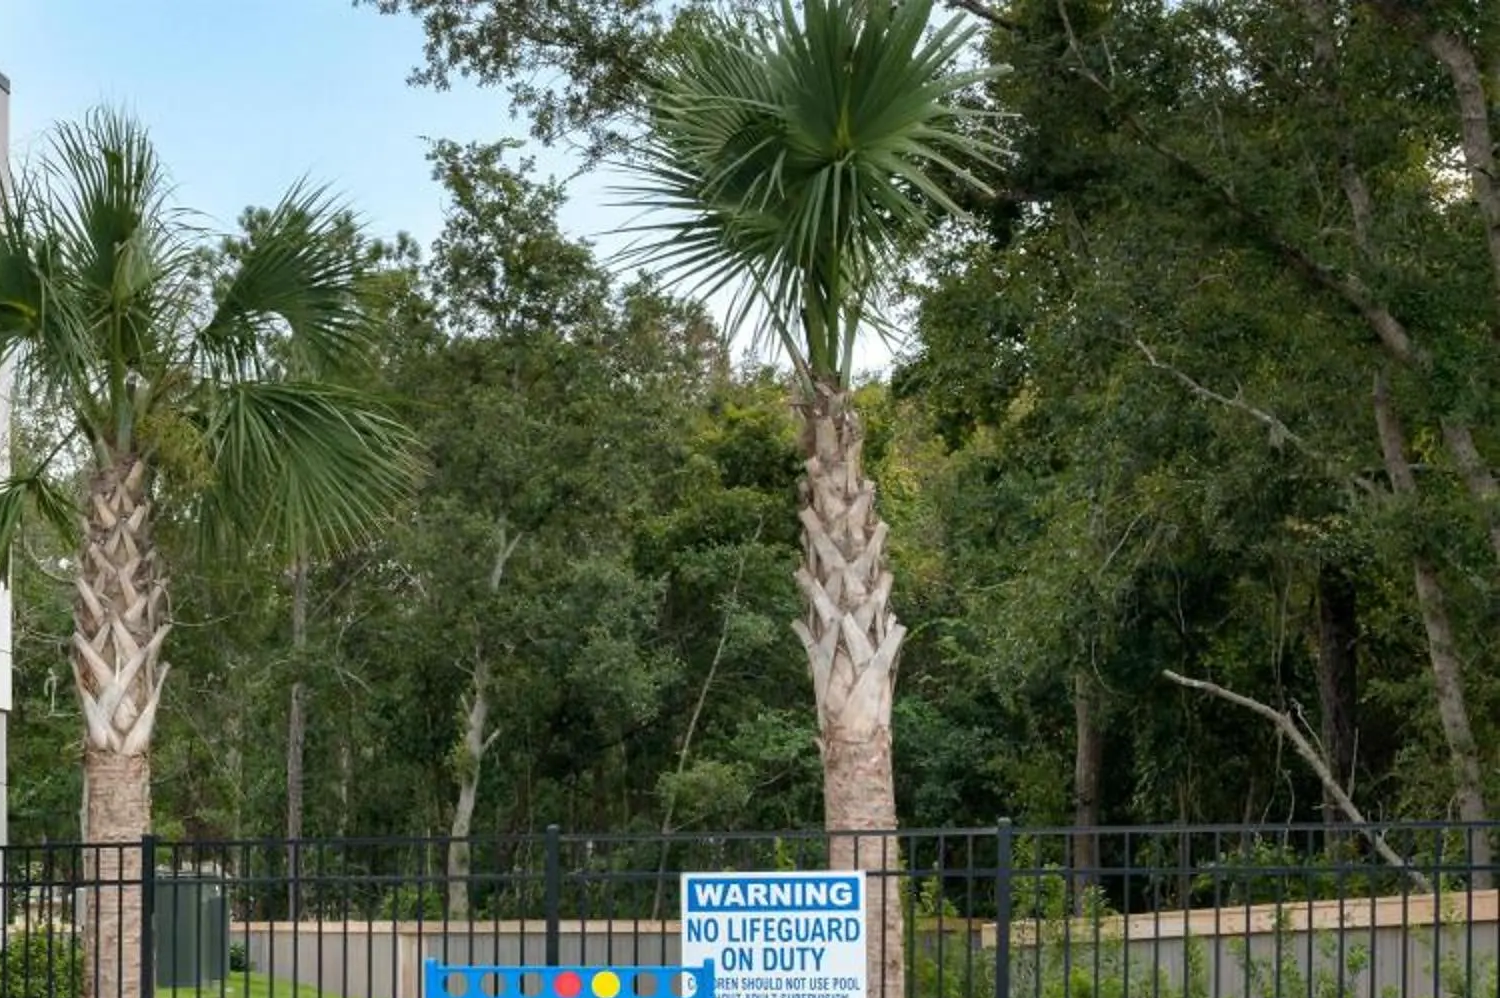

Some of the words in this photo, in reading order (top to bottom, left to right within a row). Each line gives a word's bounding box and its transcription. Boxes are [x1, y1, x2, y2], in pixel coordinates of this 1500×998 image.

[694, 883, 853, 907] WARNING
[687, 917, 719, 942] NO
[727, 917, 861, 943] LIFEGUARD
[721, 947, 753, 971] ON
[763, 947, 826, 971] DUTY
[741, 977, 783, 991] SHOULD
[785, 977, 807, 991] NOT
[809, 977, 830, 991] USE
[832, 977, 861, 991] POOL
